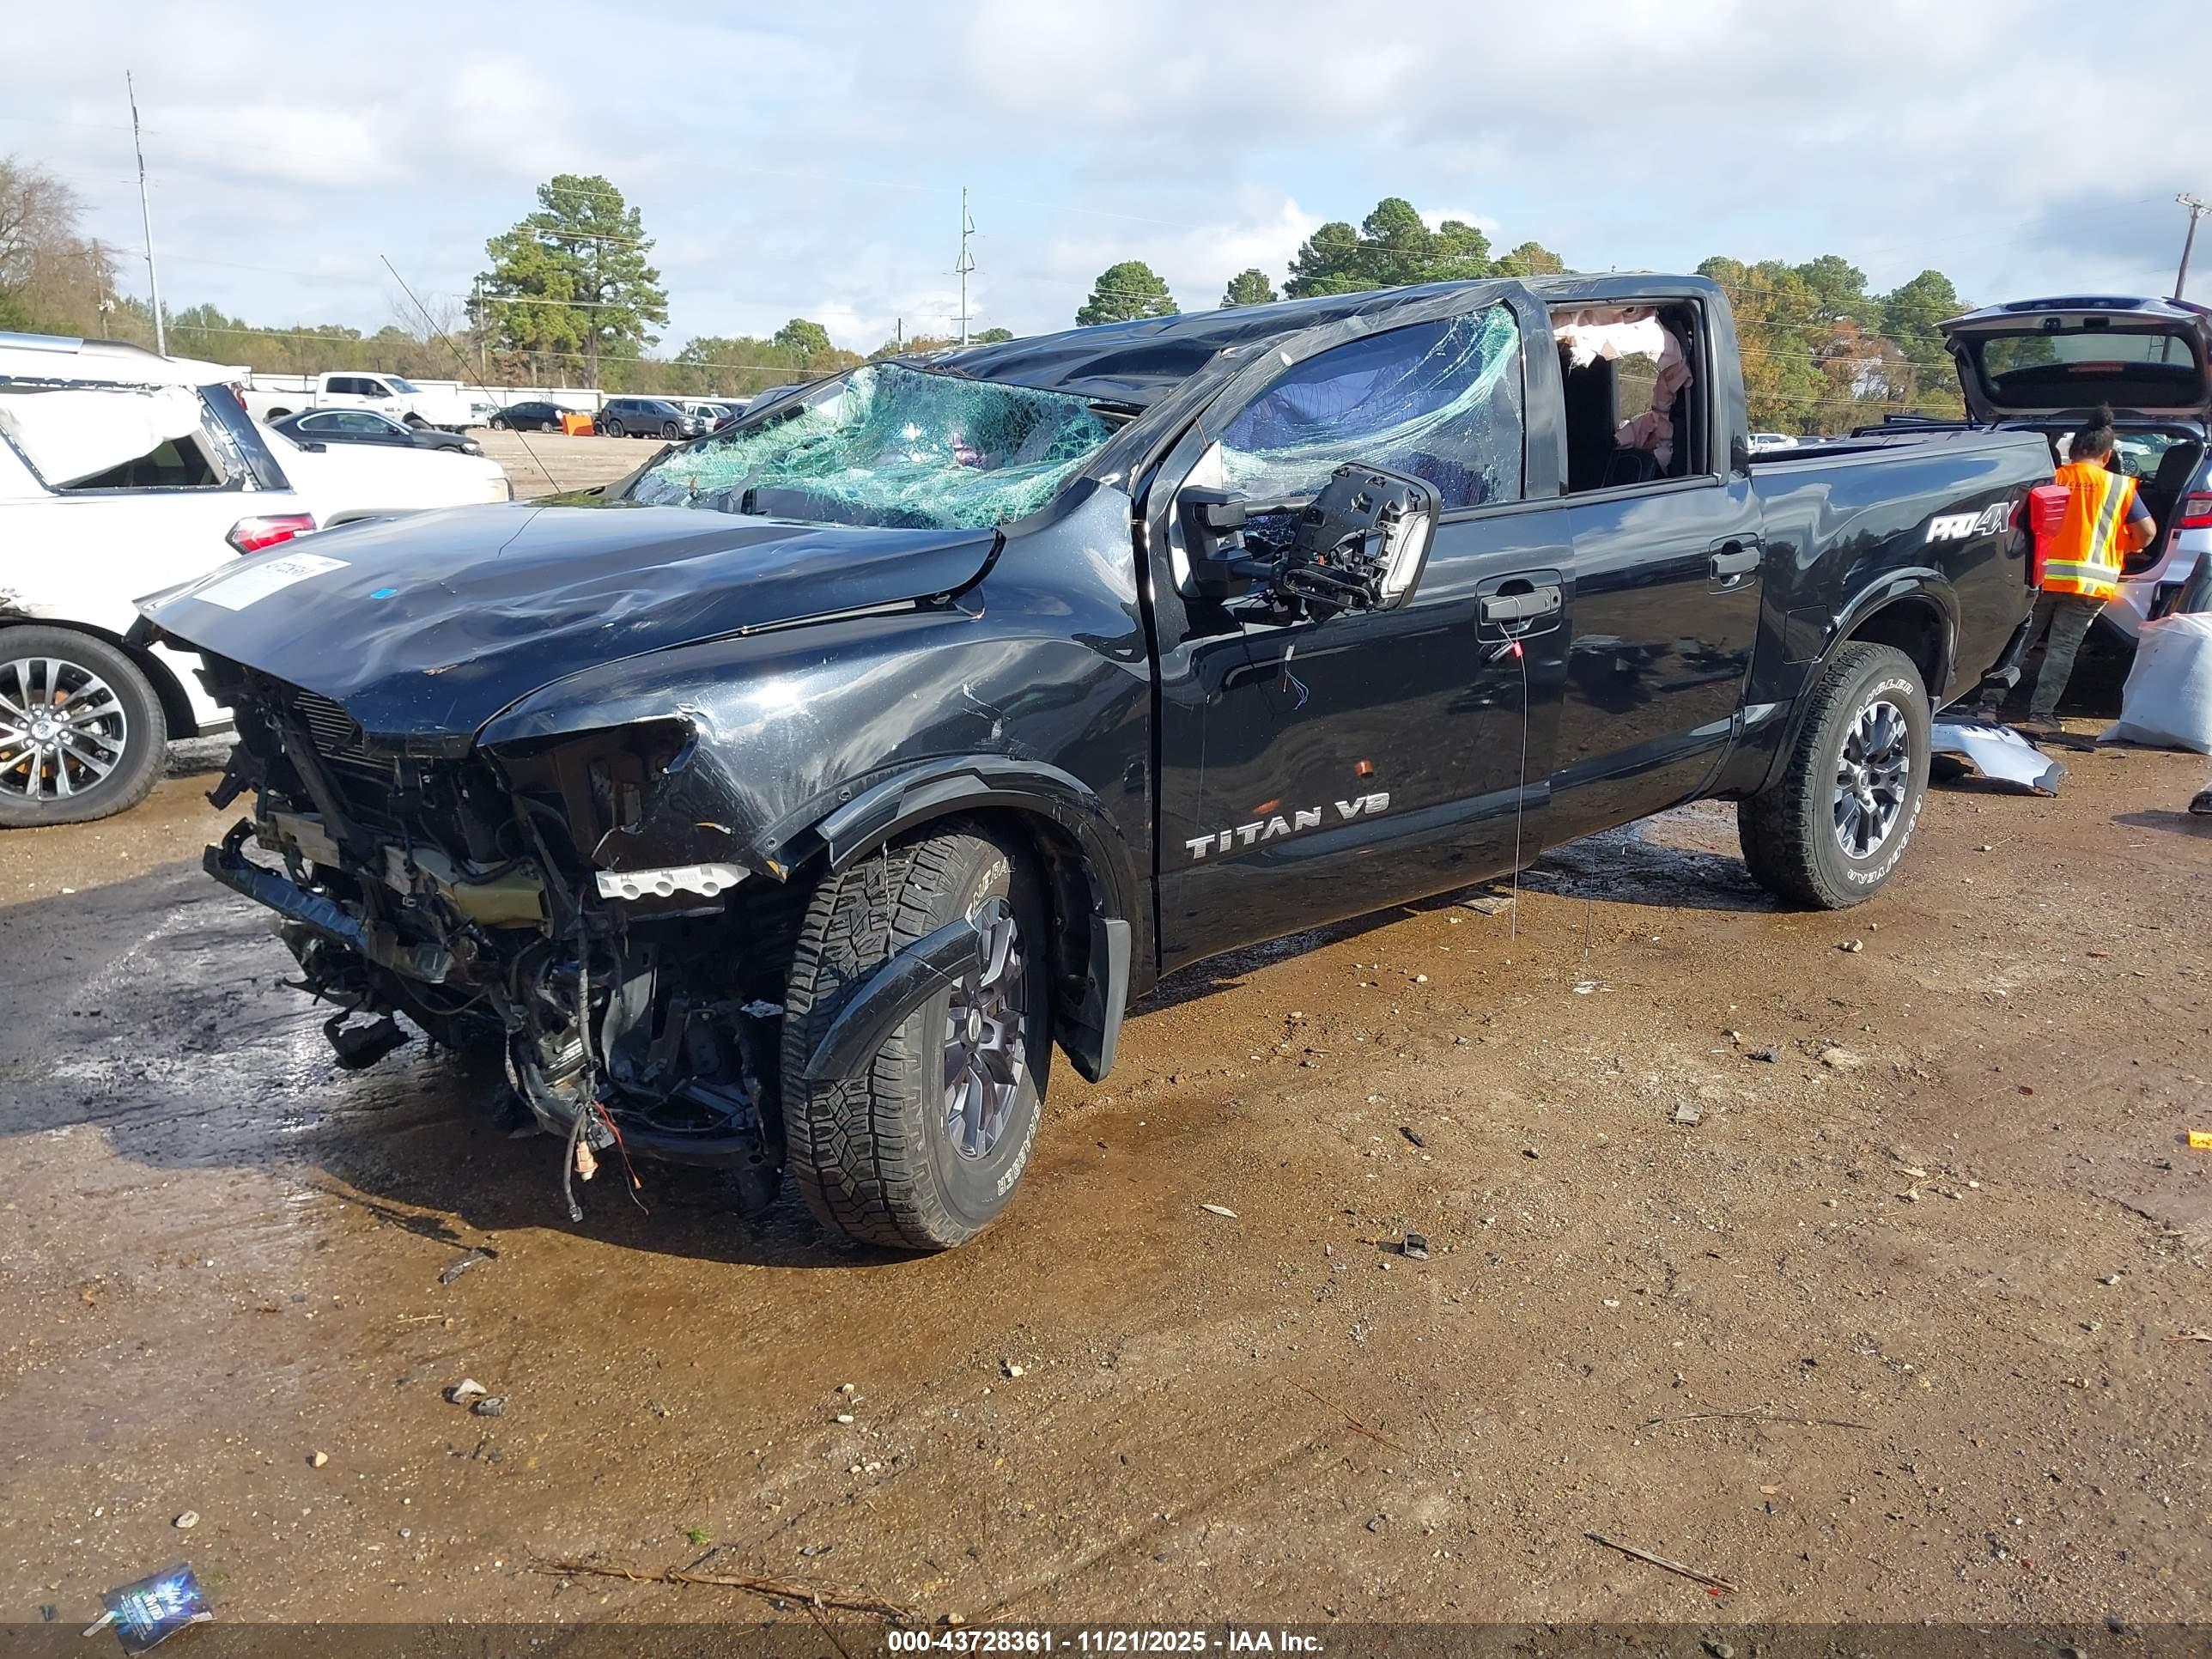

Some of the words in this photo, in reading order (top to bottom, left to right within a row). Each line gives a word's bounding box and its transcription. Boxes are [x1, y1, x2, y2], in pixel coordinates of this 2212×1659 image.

[1185, 805, 1322, 860] TITAN
[1334, 792, 1390, 820] V8
[964, 854, 1017, 921] ENERAL
[997, 1098, 1042, 1196] GRABBER
